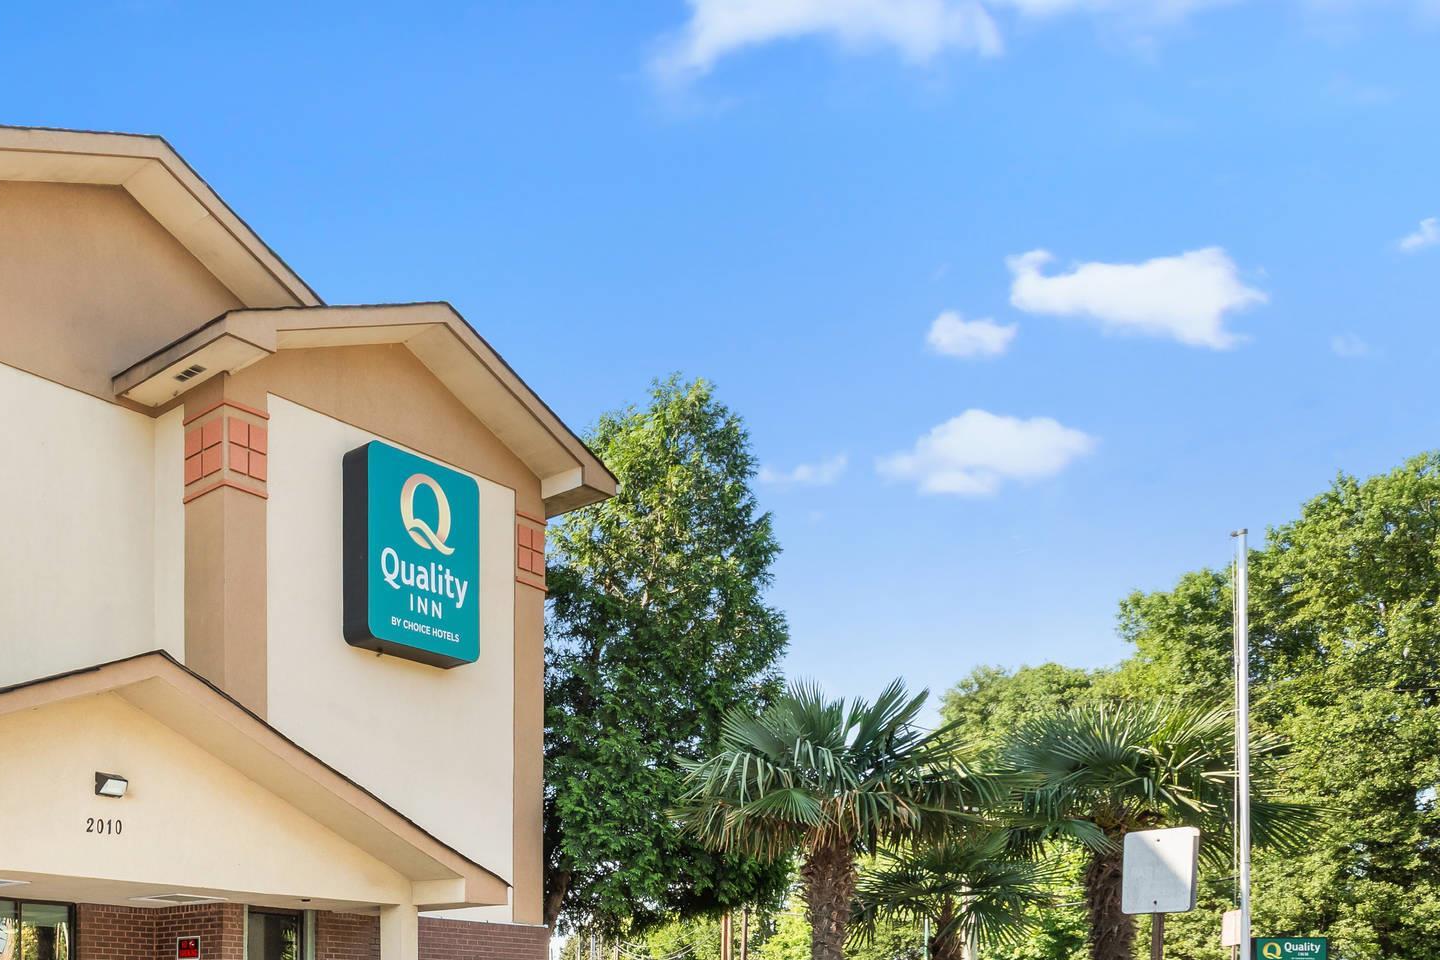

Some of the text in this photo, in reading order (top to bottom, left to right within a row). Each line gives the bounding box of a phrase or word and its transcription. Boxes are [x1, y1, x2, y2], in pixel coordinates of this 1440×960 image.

[400, 473, 455, 555] Q
[380, 547, 469, 609] Quality
[409, 593, 443, 620] INN
[391, 616, 460, 643] BY CHOICE HOTELS
[86, 817, 123, 835] 2010
[1284, 941, 1321, 954] Quality
